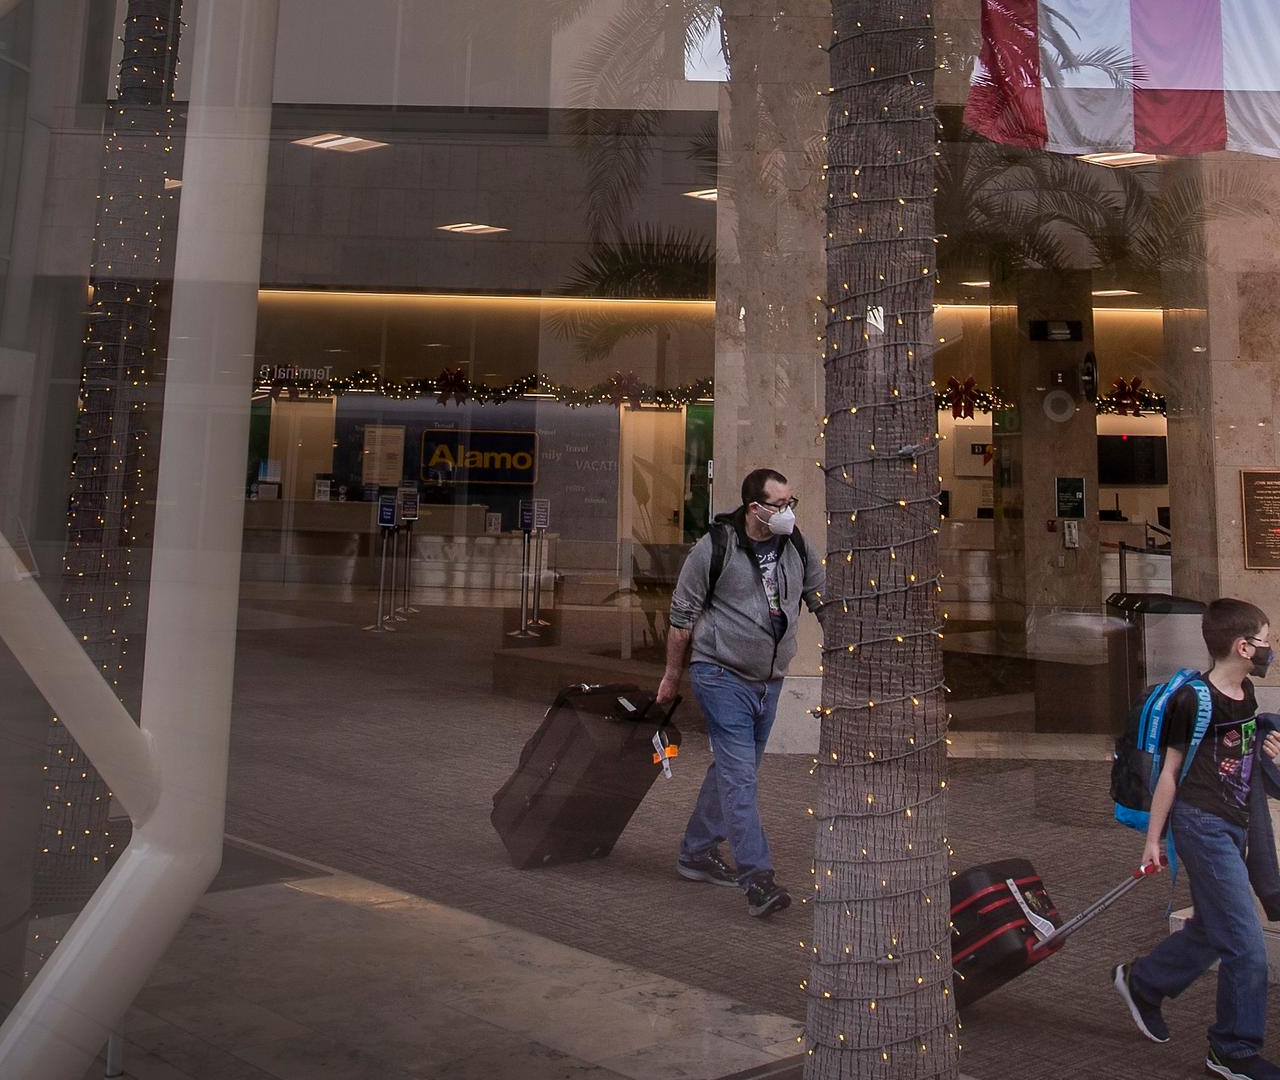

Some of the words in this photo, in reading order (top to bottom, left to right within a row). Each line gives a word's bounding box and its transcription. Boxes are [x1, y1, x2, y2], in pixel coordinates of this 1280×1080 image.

[429, 444, 533, 471] Alamo
[566, 444, 589, 453] Travel
[1191, 686, 1212, 746] FORTNITE
